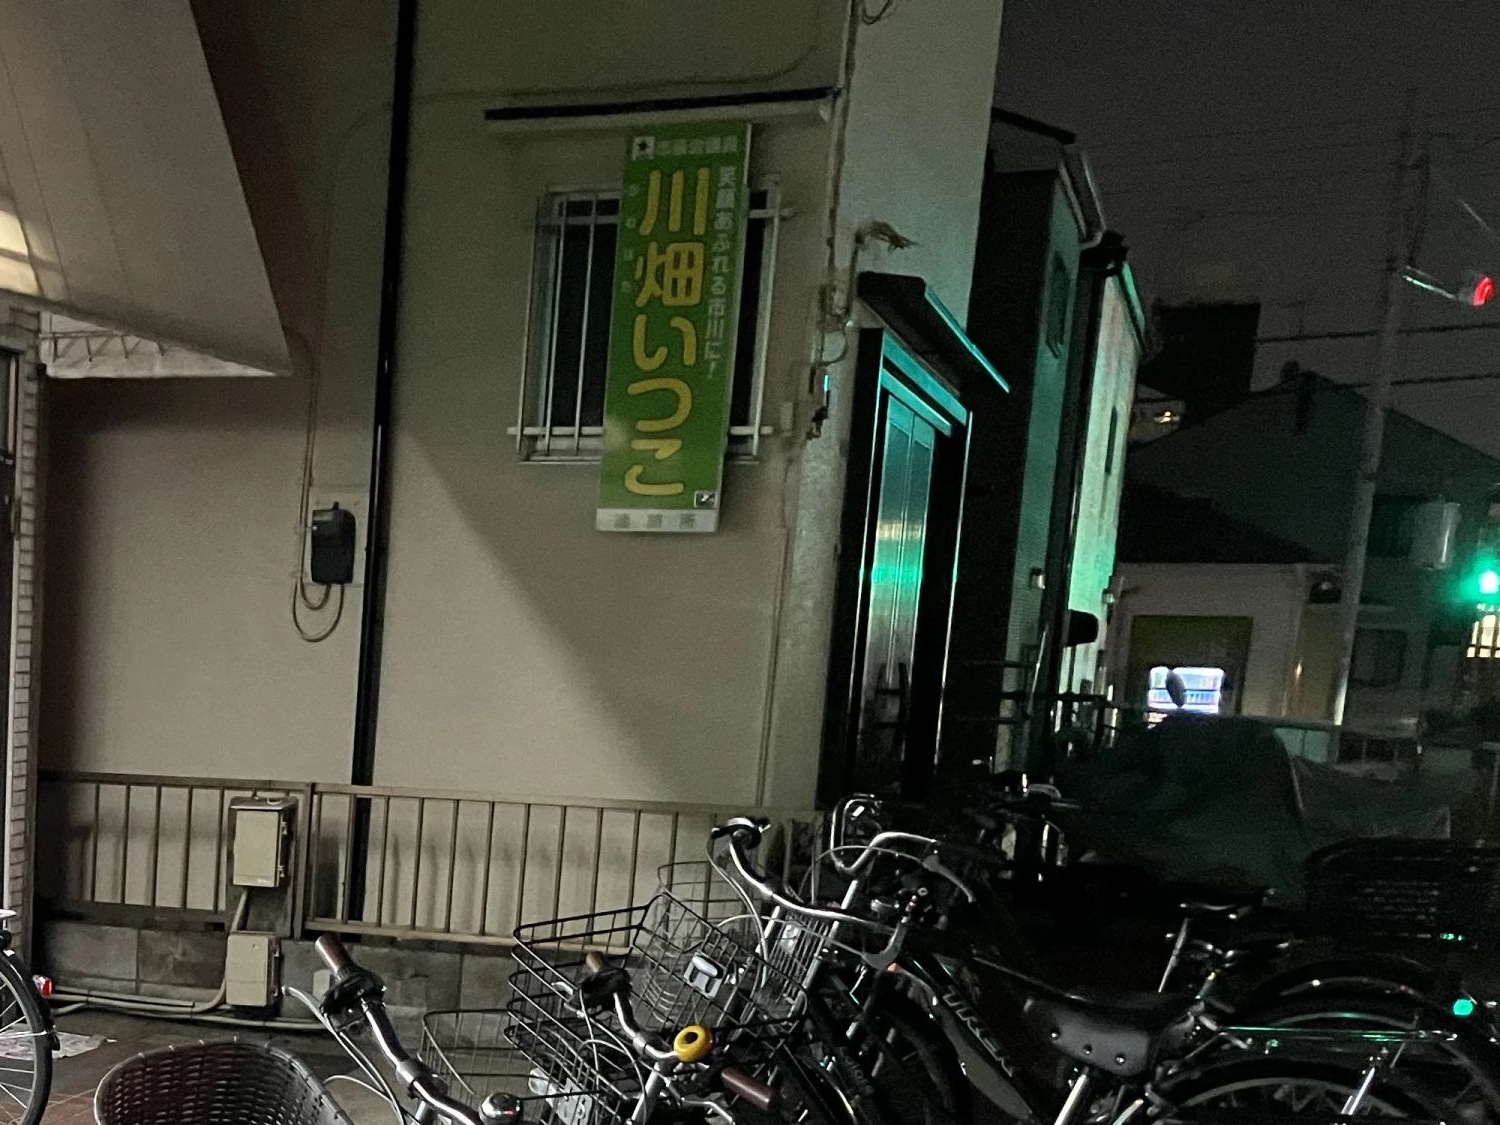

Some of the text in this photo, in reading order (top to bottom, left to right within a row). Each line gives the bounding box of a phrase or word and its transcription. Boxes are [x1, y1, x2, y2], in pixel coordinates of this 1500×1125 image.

[624, 167, 710, 496] 川畑いつこ
